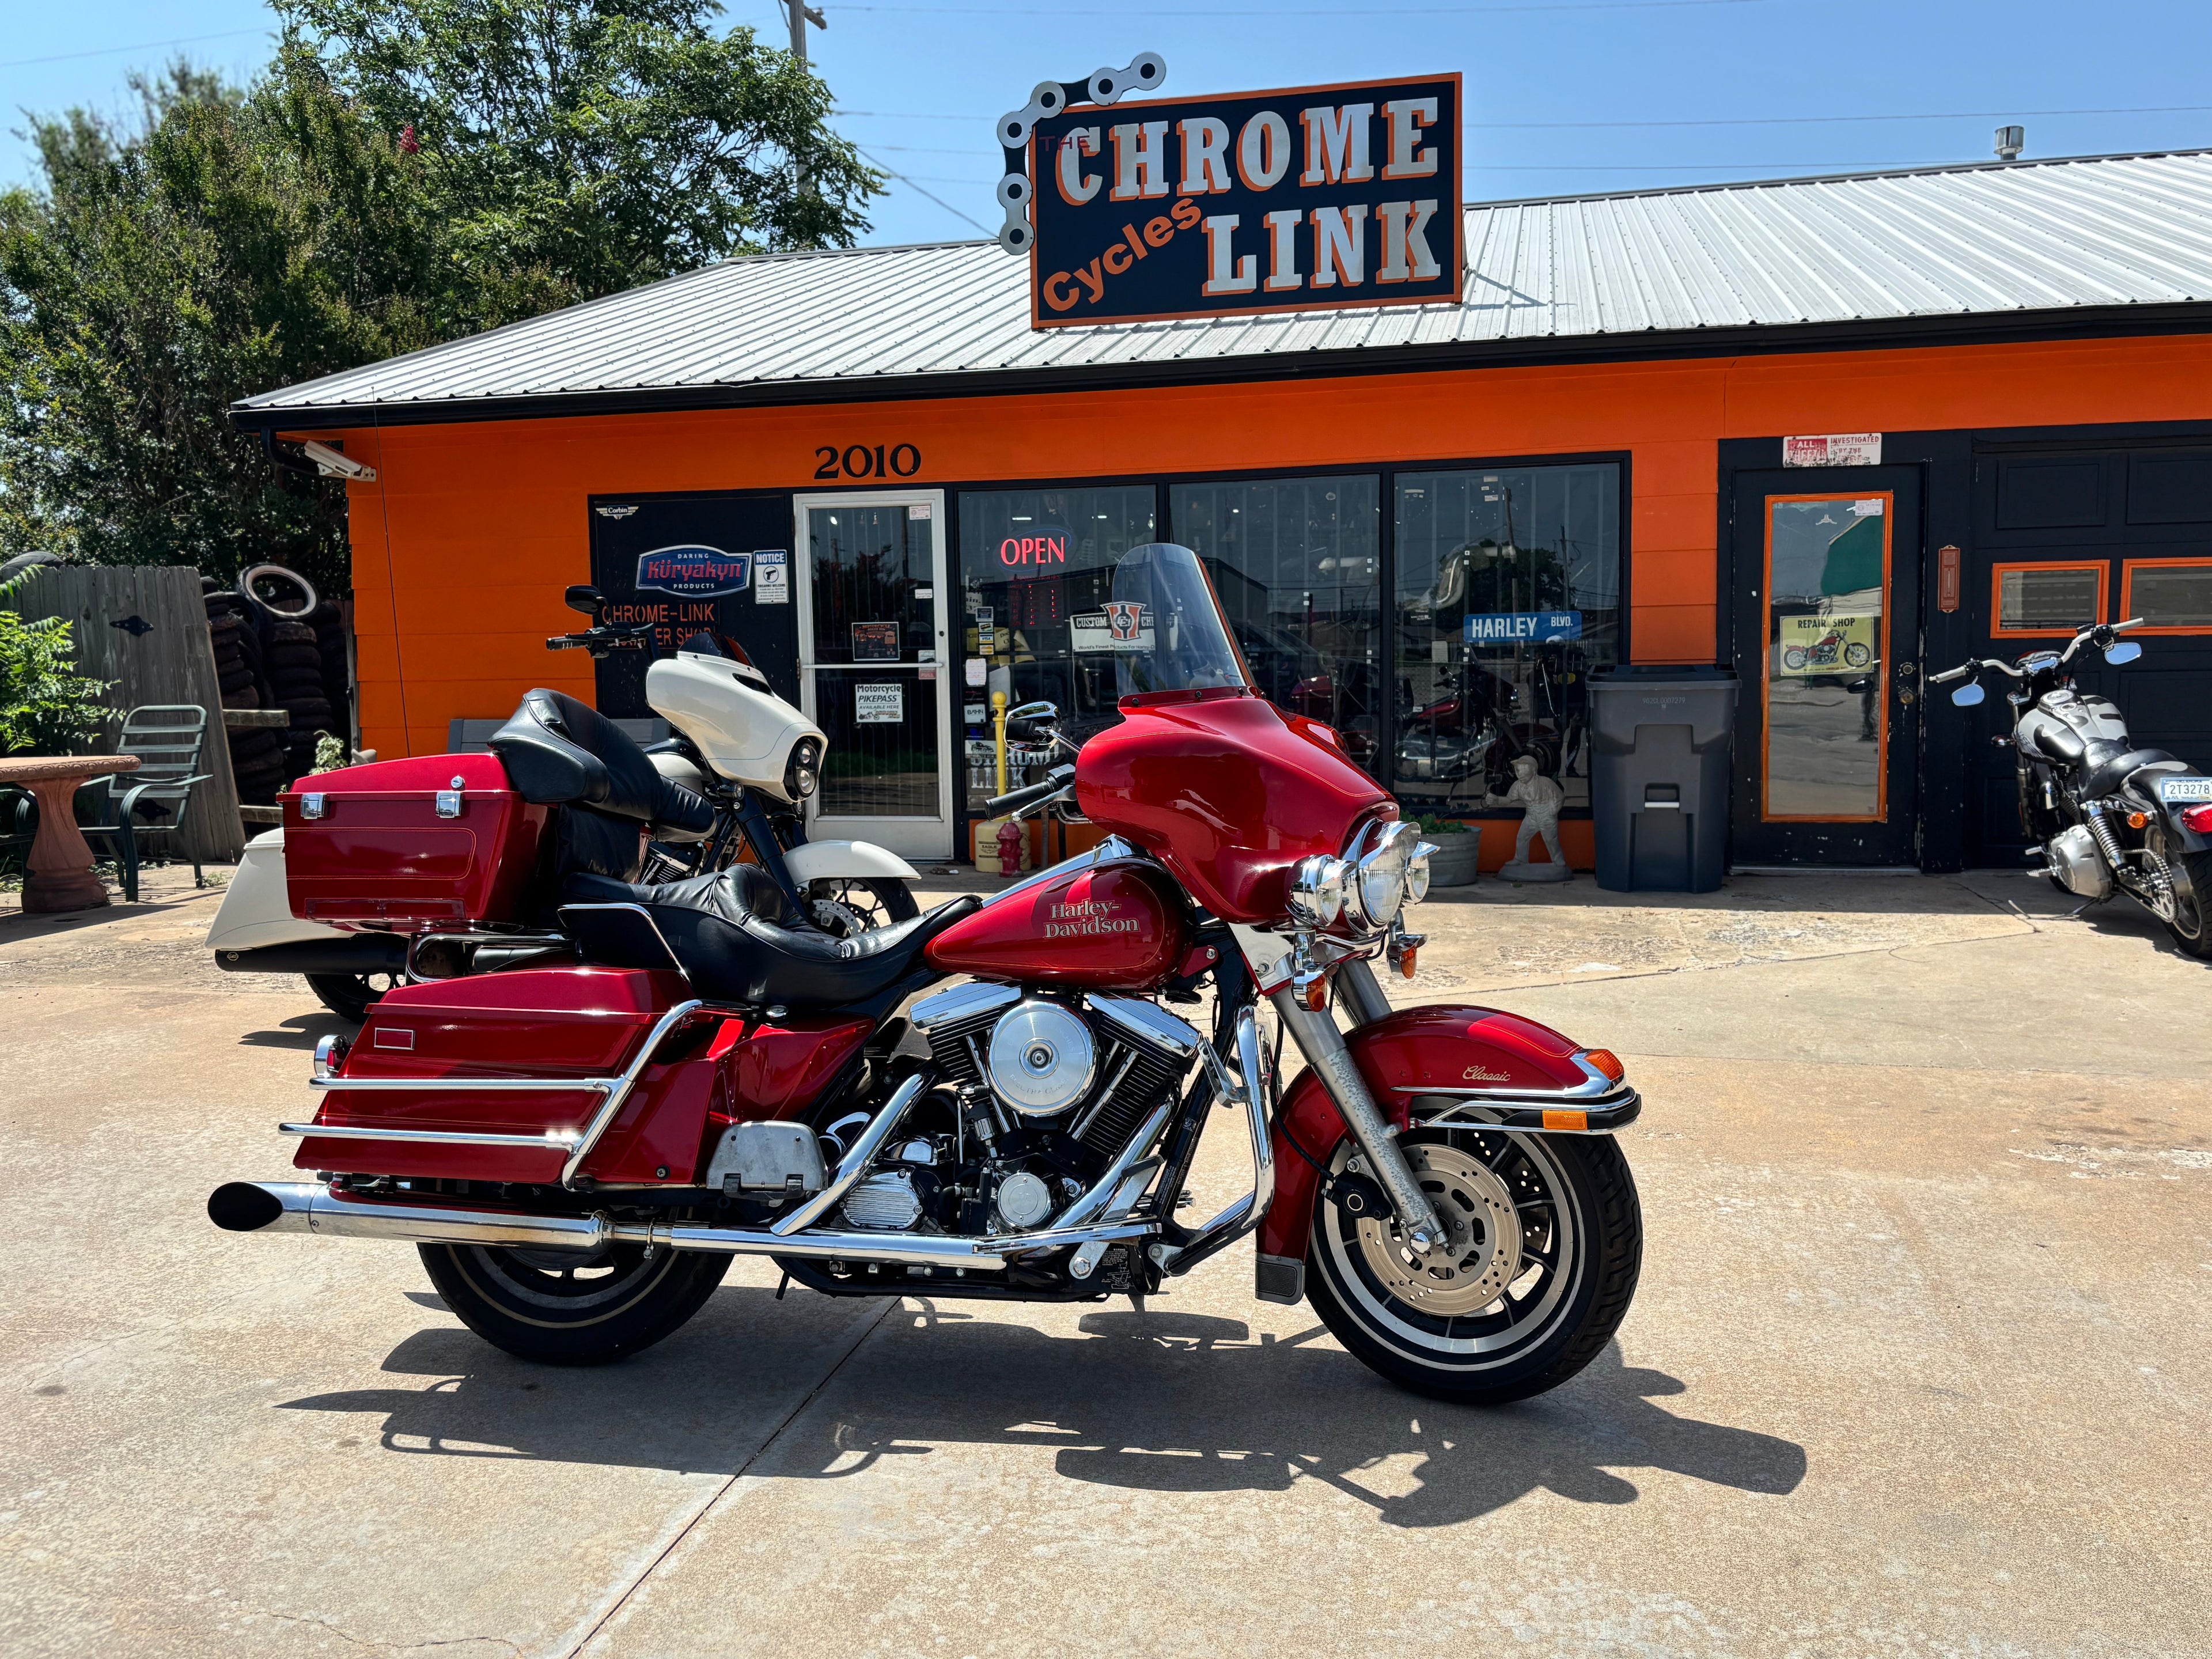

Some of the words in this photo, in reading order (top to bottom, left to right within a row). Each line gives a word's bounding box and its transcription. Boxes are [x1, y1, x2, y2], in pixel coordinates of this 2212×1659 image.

[1039, 135, 1090, 151] THE
[1056, 97, 1438, 206] CHROME
[1043, 198, 1201, 312] Cycles
[1202, 199, 1441, 297] LINK
[1831, 436, 1879, 444] INVESTIGATED
[814, 444, 921, 479] 2010
[756, 553, 785, 563] NOTICE
[1001, 537, 1065, 565] OPEN
[647, 559, 741, 582] Küryakyn
[602, 604, 714, 622] CHROME-LINK
[1076, 617, 1107, 627] CUSTOM
[1798, 619, 1826, 628] REPAIR
[1833, 618, 1855, 627] SHOP
[1472, 617, 1537, 638] HARLEY
[1551, 616, 1573, 627] BLVD.
[857, 685, 901, 694] Motorcycle
[971, 767, 1027, 789] LIK
[2170, 785, 2210, 794] 2T3278
[1050, 899, 1120, 921] Harley-
[1044, 915, 1139, 938] Davidson
[1463, 1066, 1510, 1081] Classic
